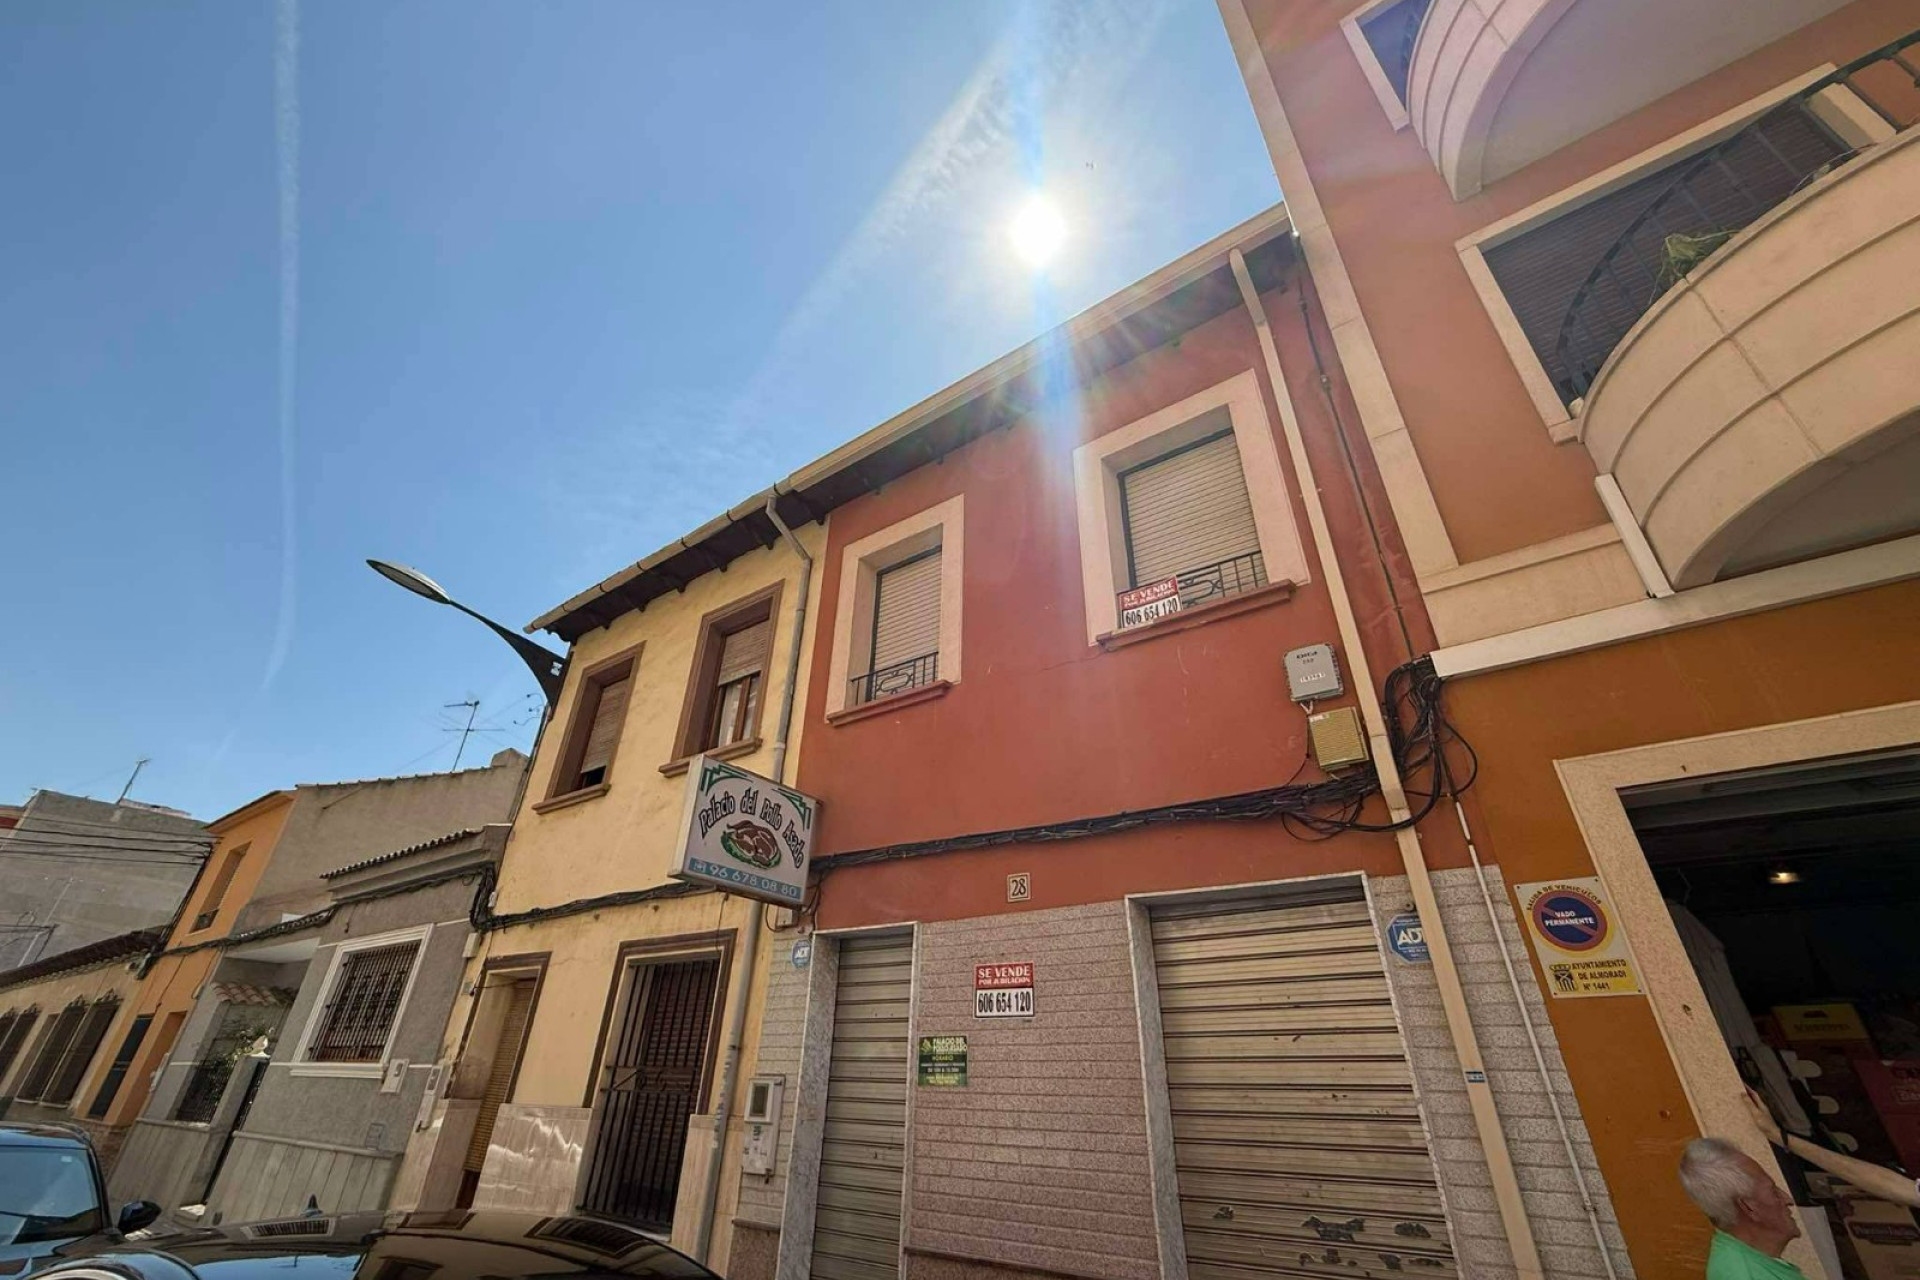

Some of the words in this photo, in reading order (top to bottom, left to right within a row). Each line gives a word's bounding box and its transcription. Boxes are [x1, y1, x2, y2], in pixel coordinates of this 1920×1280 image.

[1123, 593, 1138, 602] SE
[1139, 580, 1174, 596] VENDE
[1125, 609, 1142, 625] 606
[1144, 604, 1160, 621] 654
[1162, 597, 1178, 616] 120
[698, 791, 736, 840] Palacio
[740, 786, 759, 816] del
[760, 797, 783, 831] Pollo
[781, 819, 806, 869] Asado
[709, 865, 728, 878] 96
[731, 872, 758, 887] 678
[760, 878, 778, 892] 08
[780, 883, 798, 897] 80
[1011, 878, 1027, 897] 28
[1544, 916, 1595, 927] PERMANENTE
[1554, 910, 1576, 918] VADO
[977, 968, 992, 978] SE
[995, 965, 1031, 978] VENDE
[1571, 958, 1627, 970] AYUNTAMIENTO
[1578, 972, 1588, 980] DE
[1592, 981, 1610, 990] 1441
[978, 993, 994, 1013] 606
[996, 992, 1012, 1013] 654
[1014, 991, 1031, 1012] 120
